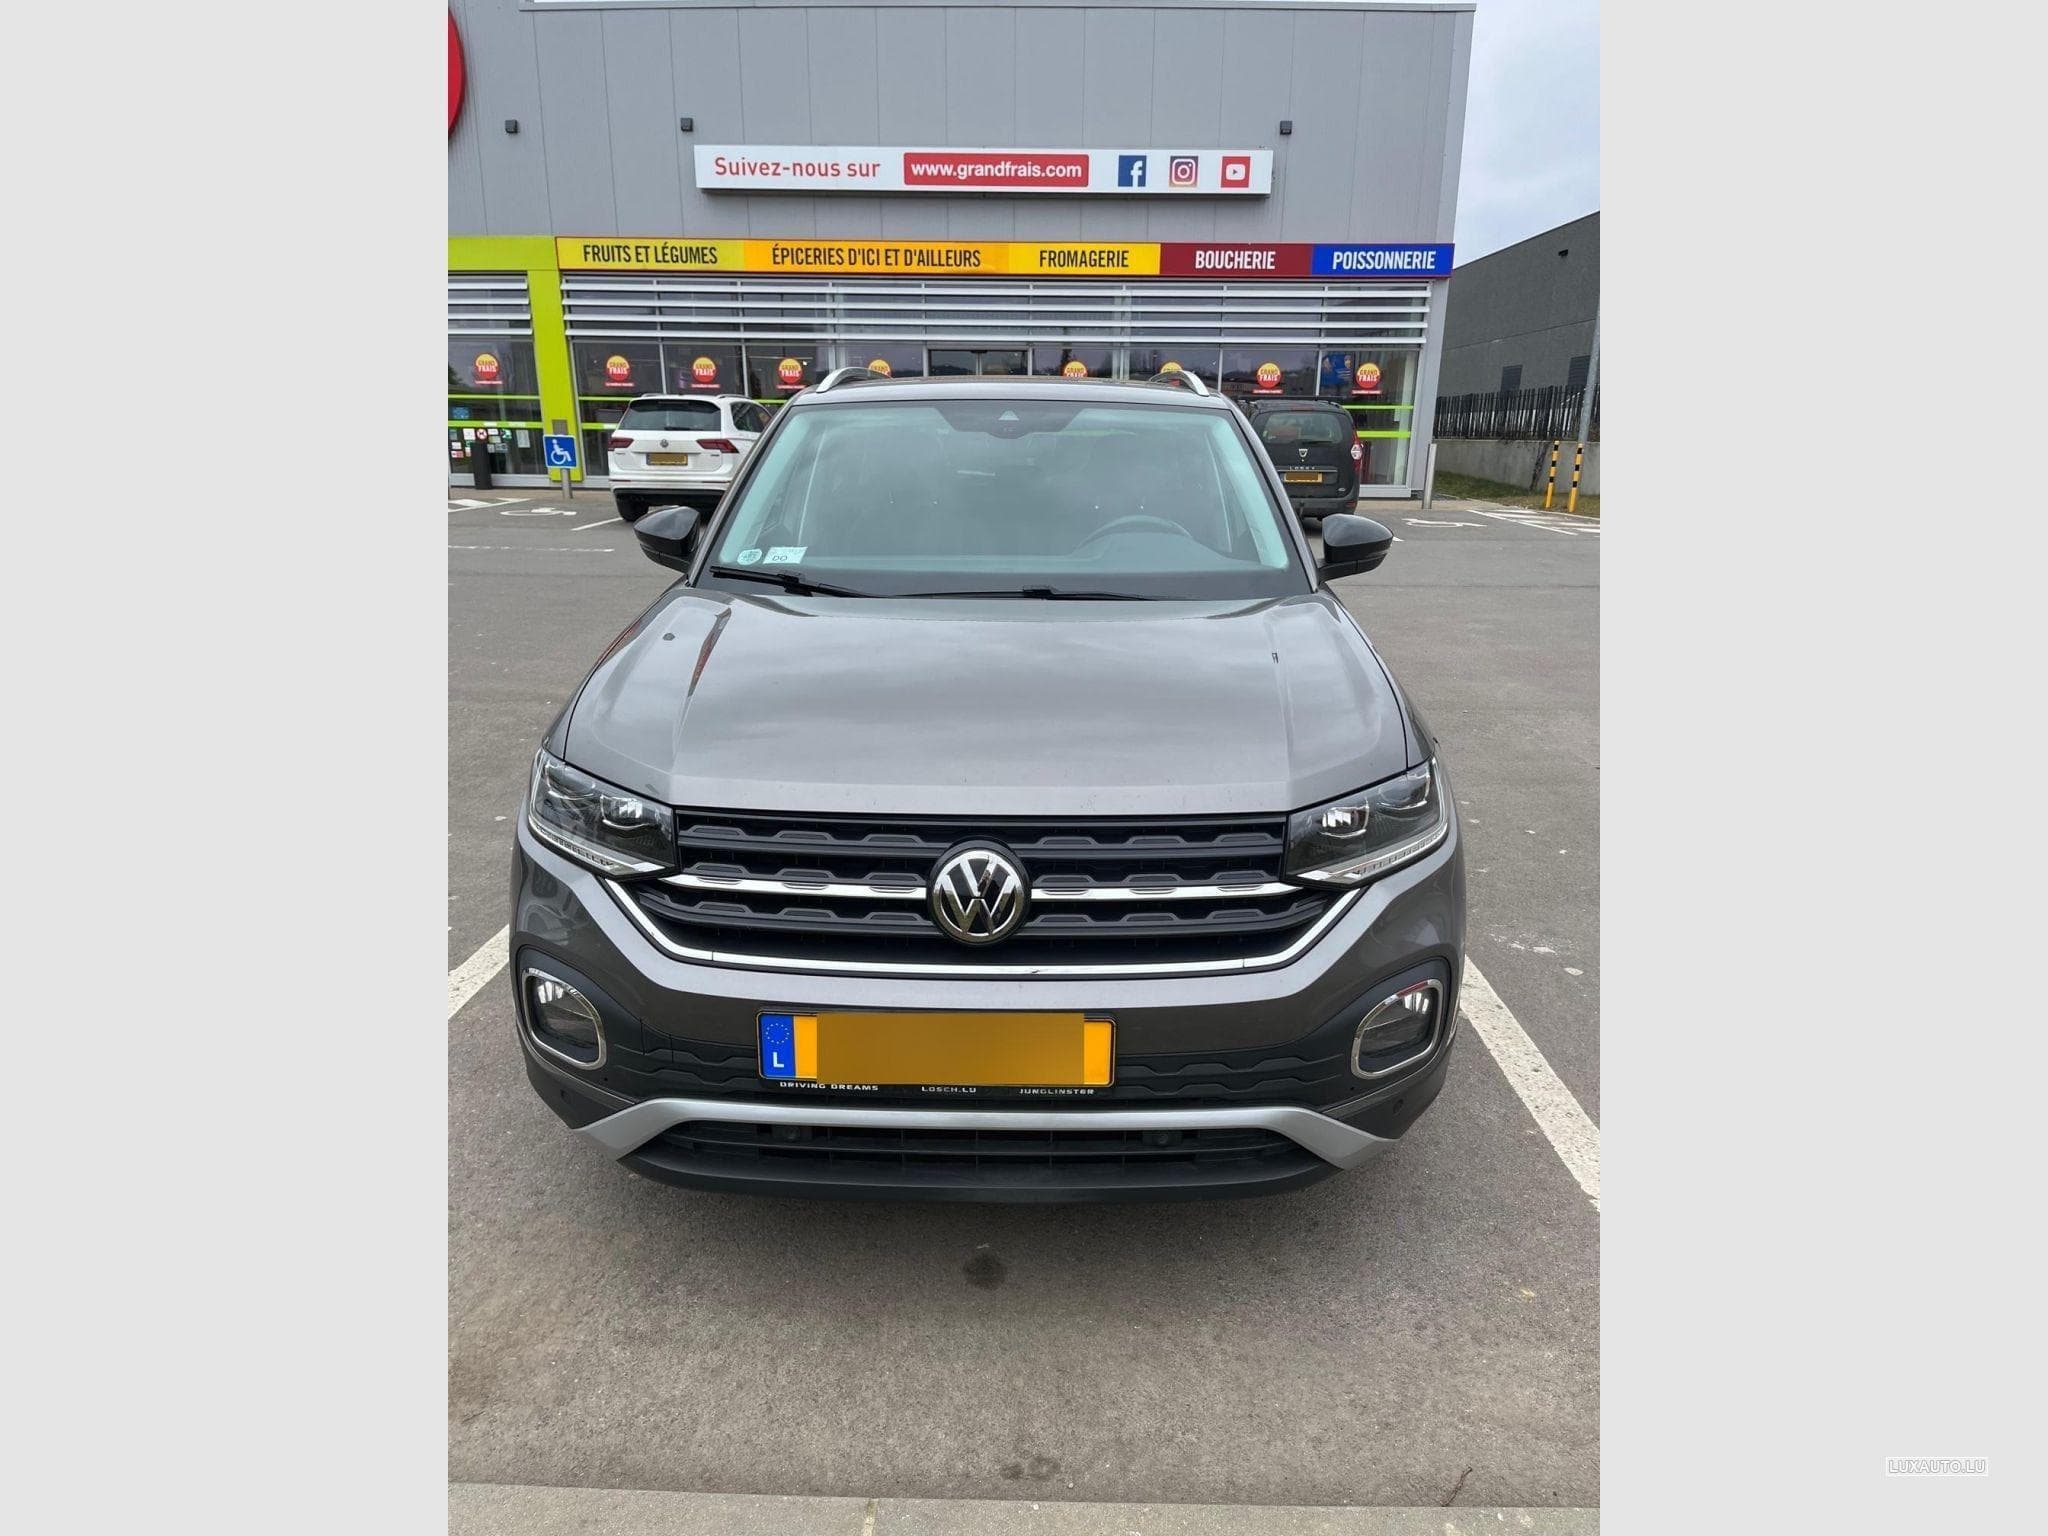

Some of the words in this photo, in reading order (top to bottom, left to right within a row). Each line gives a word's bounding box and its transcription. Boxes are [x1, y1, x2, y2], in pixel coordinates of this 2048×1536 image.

[715, 157, 840, 177] Suivez-nous
[847, 163, 881, 178] sur
[911, 161, 1082, 180] www.grandfrais.com
[583, 245, 631, 263] FRUITS
[635, 246, 651, 264] ET
[654, 242, 718, 265] LÉGUMES
[772, 243, 844, 266] ÉPICERIES
[848, 248, 880, 267] D'ICI
[885, 249, 901, 267] ET
[904, 248, 981, 268] D'AILLEURS
[1039, 250, 1130, 268] FROMAGERIE
[1195, 250, 1276, 270] BOUCHERIE
[1332, 251, 1437, 270] POISSONNERIE
[772, 1051, 785, 1068] L
[780, 1081, 827, 1090] DRIVING
[830, 1084, 879, 1092] DREAMS
[921, 1086, 977, 1094] LOSCH.LU
[1019, 1088, 1095, 1096] JUNGLINSTER
